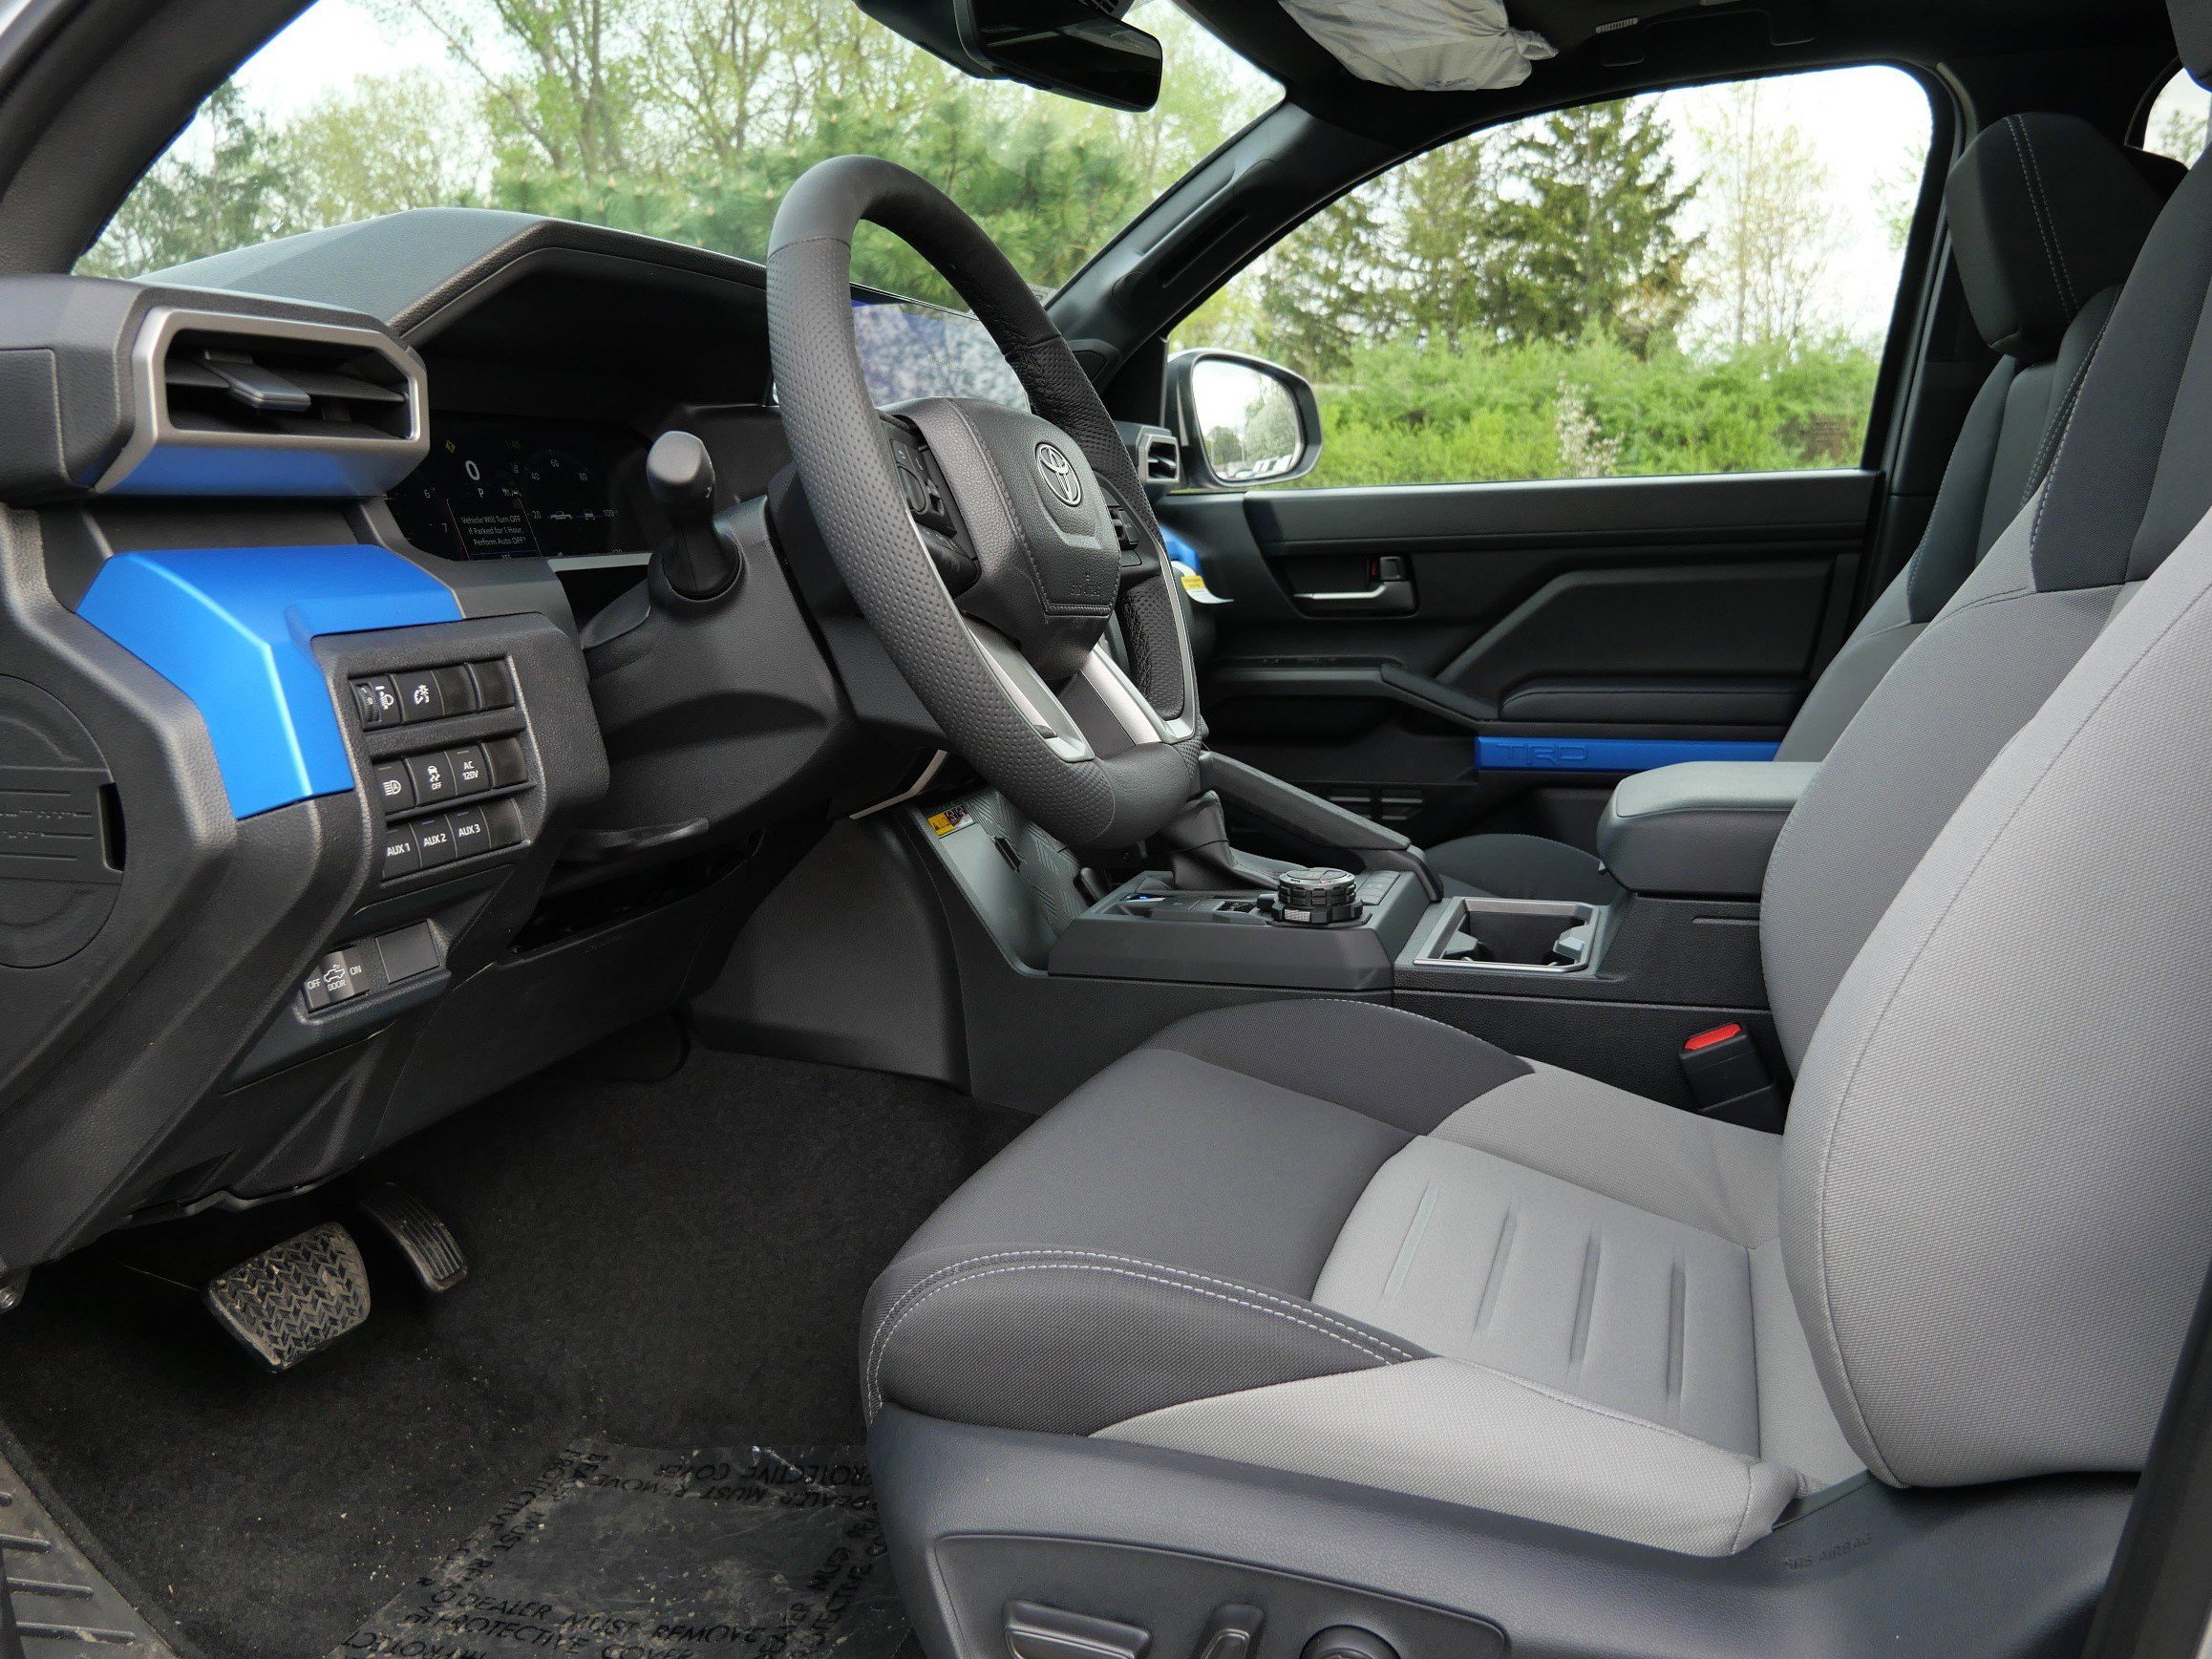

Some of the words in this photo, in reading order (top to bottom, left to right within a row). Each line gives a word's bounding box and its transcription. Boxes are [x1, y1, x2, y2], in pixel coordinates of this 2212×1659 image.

[465, 459, 480, 480] 0
[478, 488, 484, 498] P
[461, 516, 483, 524] Vehicle
[1496, 743, 1588, 765] TRD
[463, 760, 475, 771] AC
[462, 770, 479, 780] 120V
[431, 781, 442, 791] OFF
[458, 826, 473, 838] AUX
[423, 836, 438, 847] AUX
[386, 844, 404, 857] AUX
[350, 965, 361, 975] ON
[308, 978, 321, 989] OFF
[327, 979, 347, 991] DOOR
[700, 1485, 766, 1504] MUST
[458, 1593, 552, 1620] DEALER
